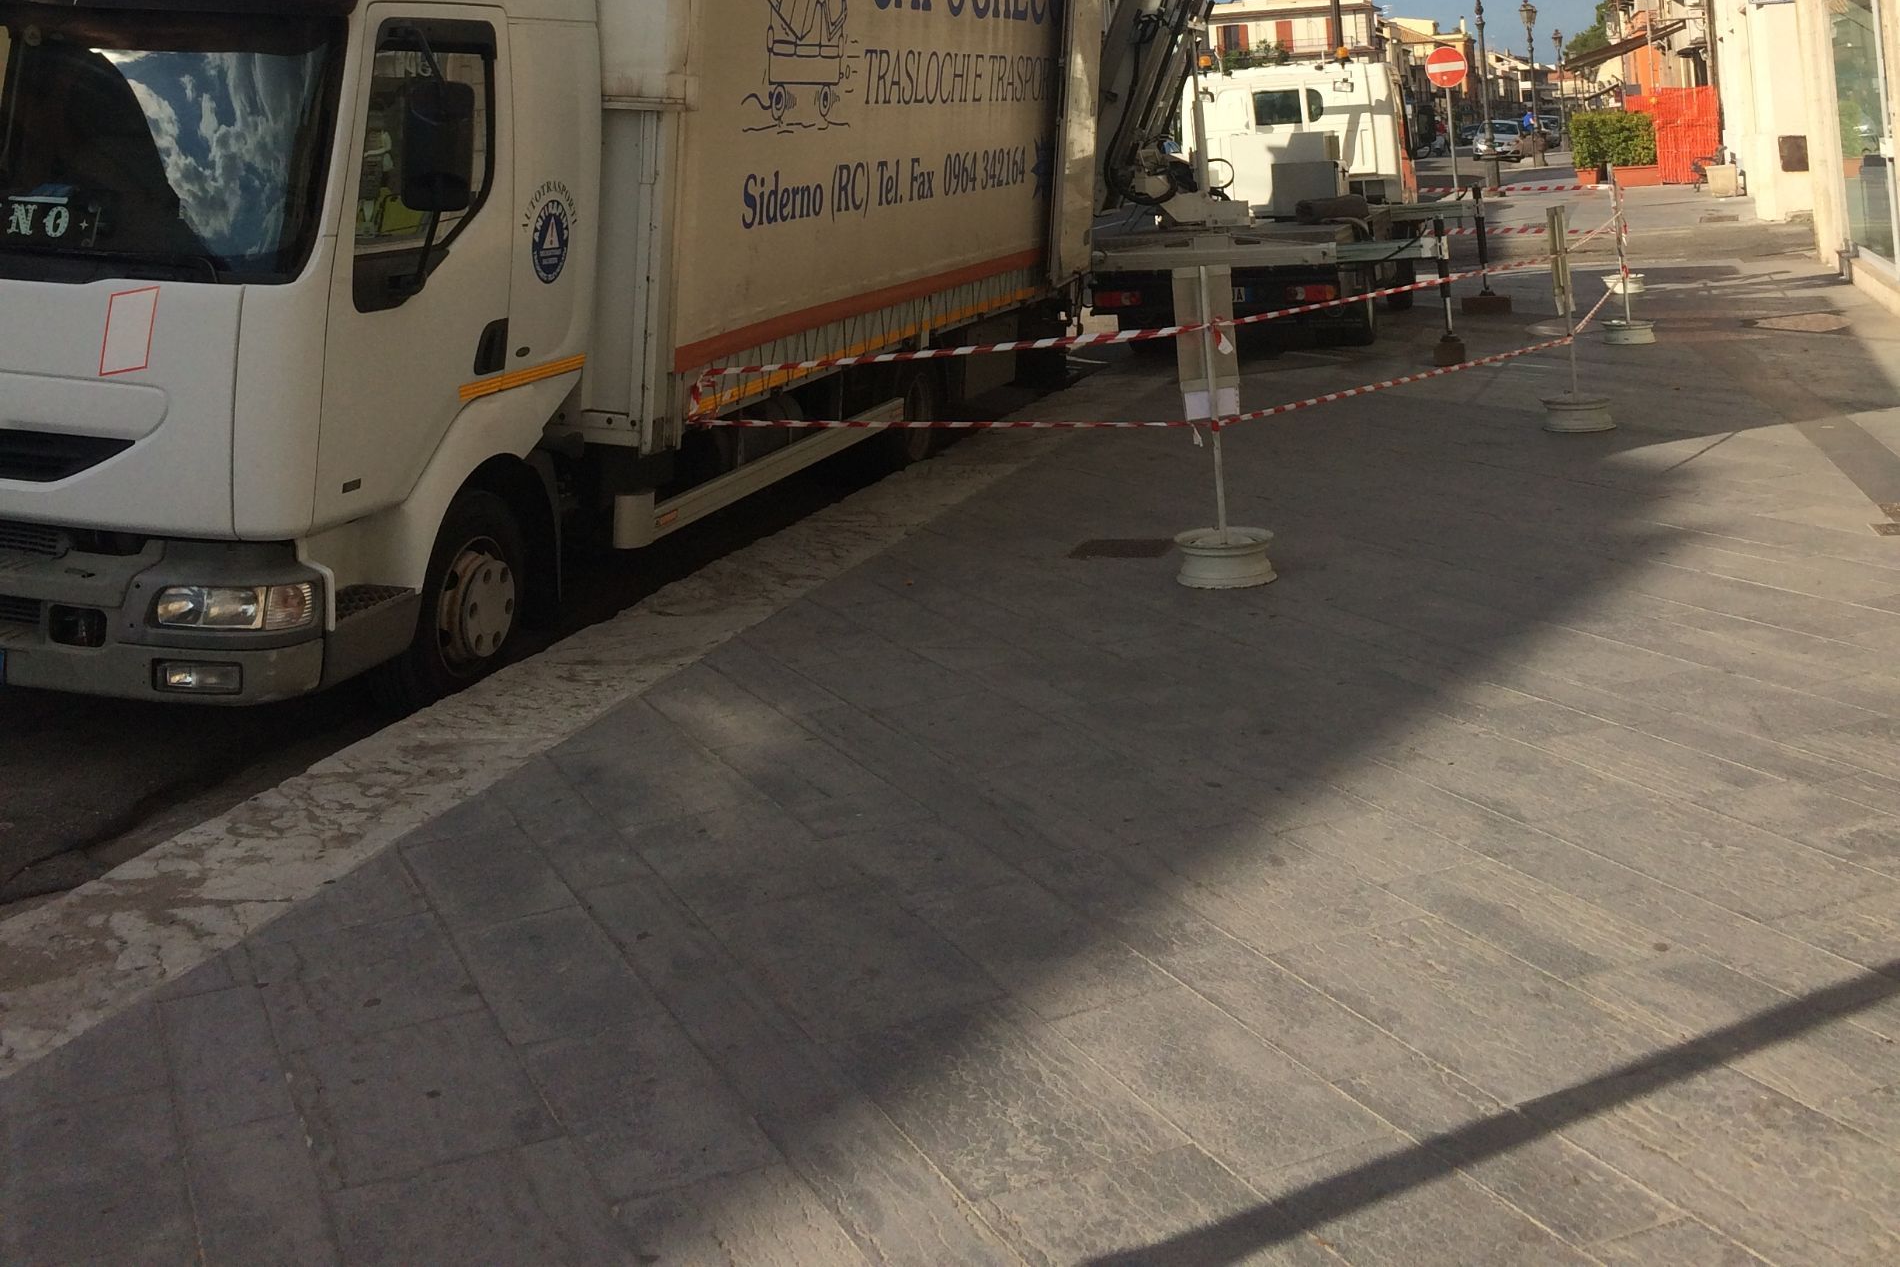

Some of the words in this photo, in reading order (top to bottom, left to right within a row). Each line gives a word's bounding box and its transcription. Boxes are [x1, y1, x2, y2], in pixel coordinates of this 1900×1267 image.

[864, 49, 970, 104] TRASLOCHI
[972, 54, 985, 103] E
[988, 54, 1053, 102] TRASPOR
[742, 170, 823, 229] Siderno
[831, 161, 870, 222] (RC)
[877, 159, 903, 207] Tel.
[908, 157, 935, 202] Fax
[943, 151, 977, 196] 0964
[981, 146, 1026, 190] 342164
